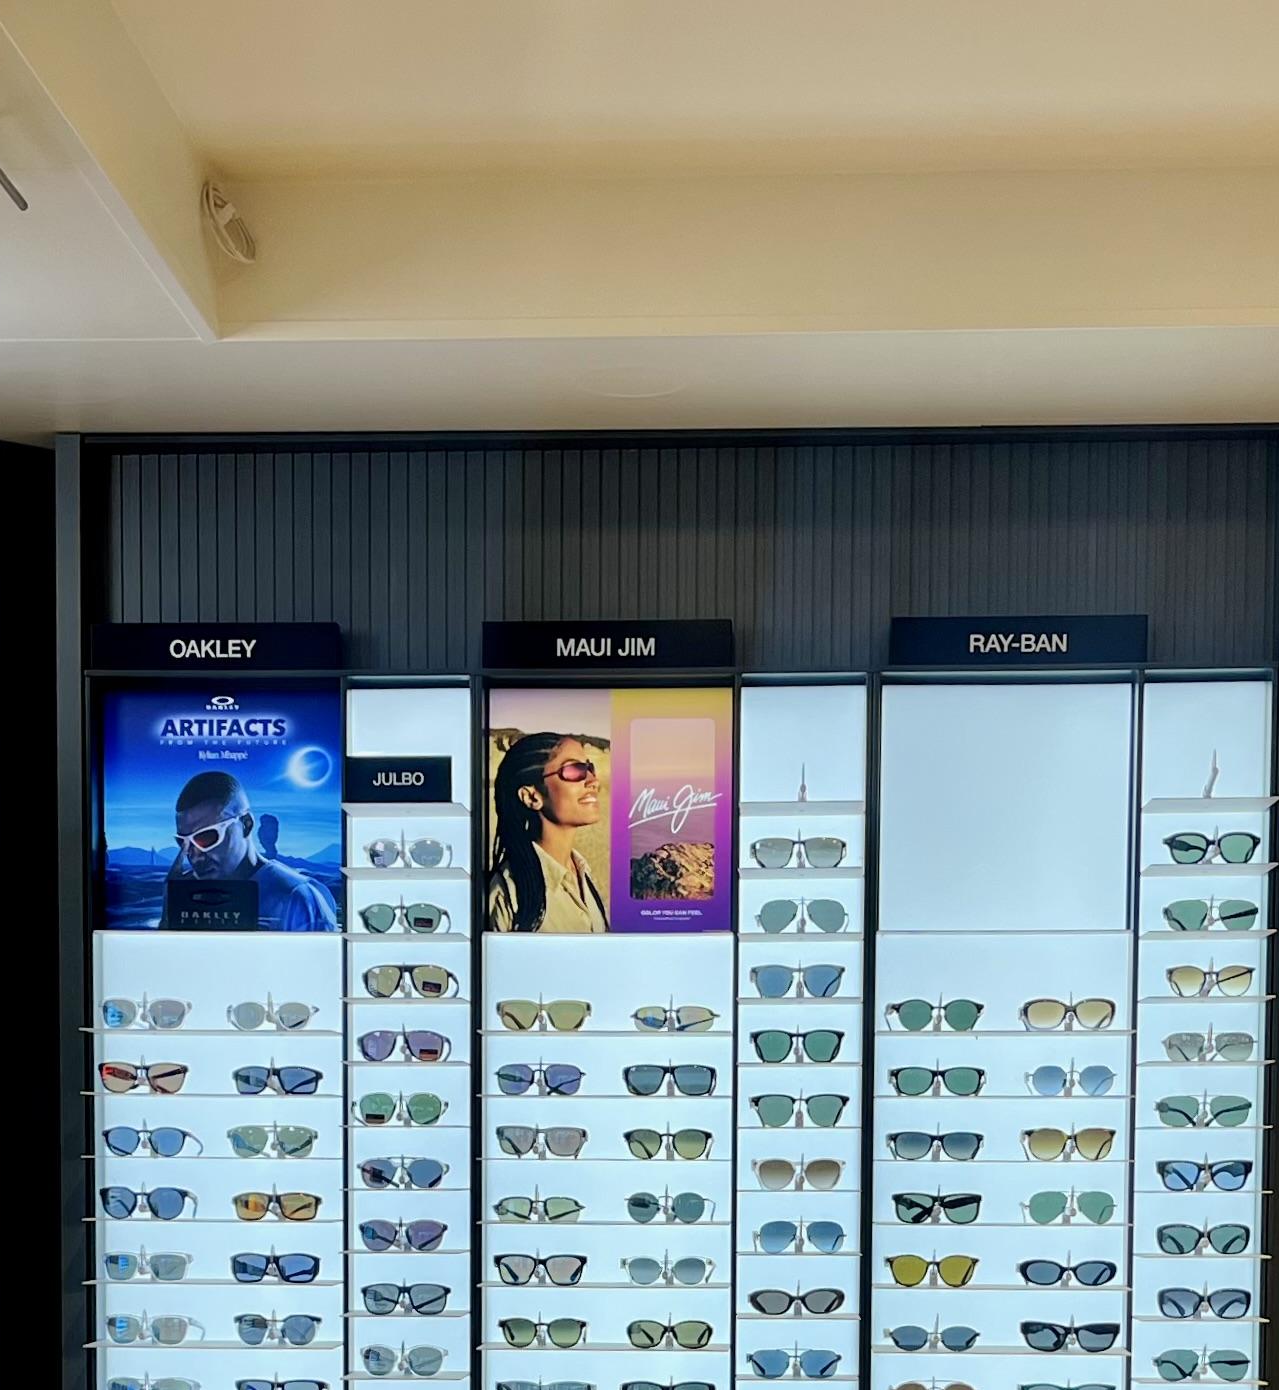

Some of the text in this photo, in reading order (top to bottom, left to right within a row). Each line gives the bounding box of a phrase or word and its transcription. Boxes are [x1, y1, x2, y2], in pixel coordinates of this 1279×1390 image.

[169, 639, 257, 659] OAKLEY
[556, 637, 656, 657] MAUI JIM
[969, 633, 1068, 653] RAY-BAN
[160, 718, 287, 737] ARTIFACTS
[372, 771, 425, 786] JULBO
[629, 784, 723, 834] Maui Jim
[180, 911, 241, 919] OAKLEY
